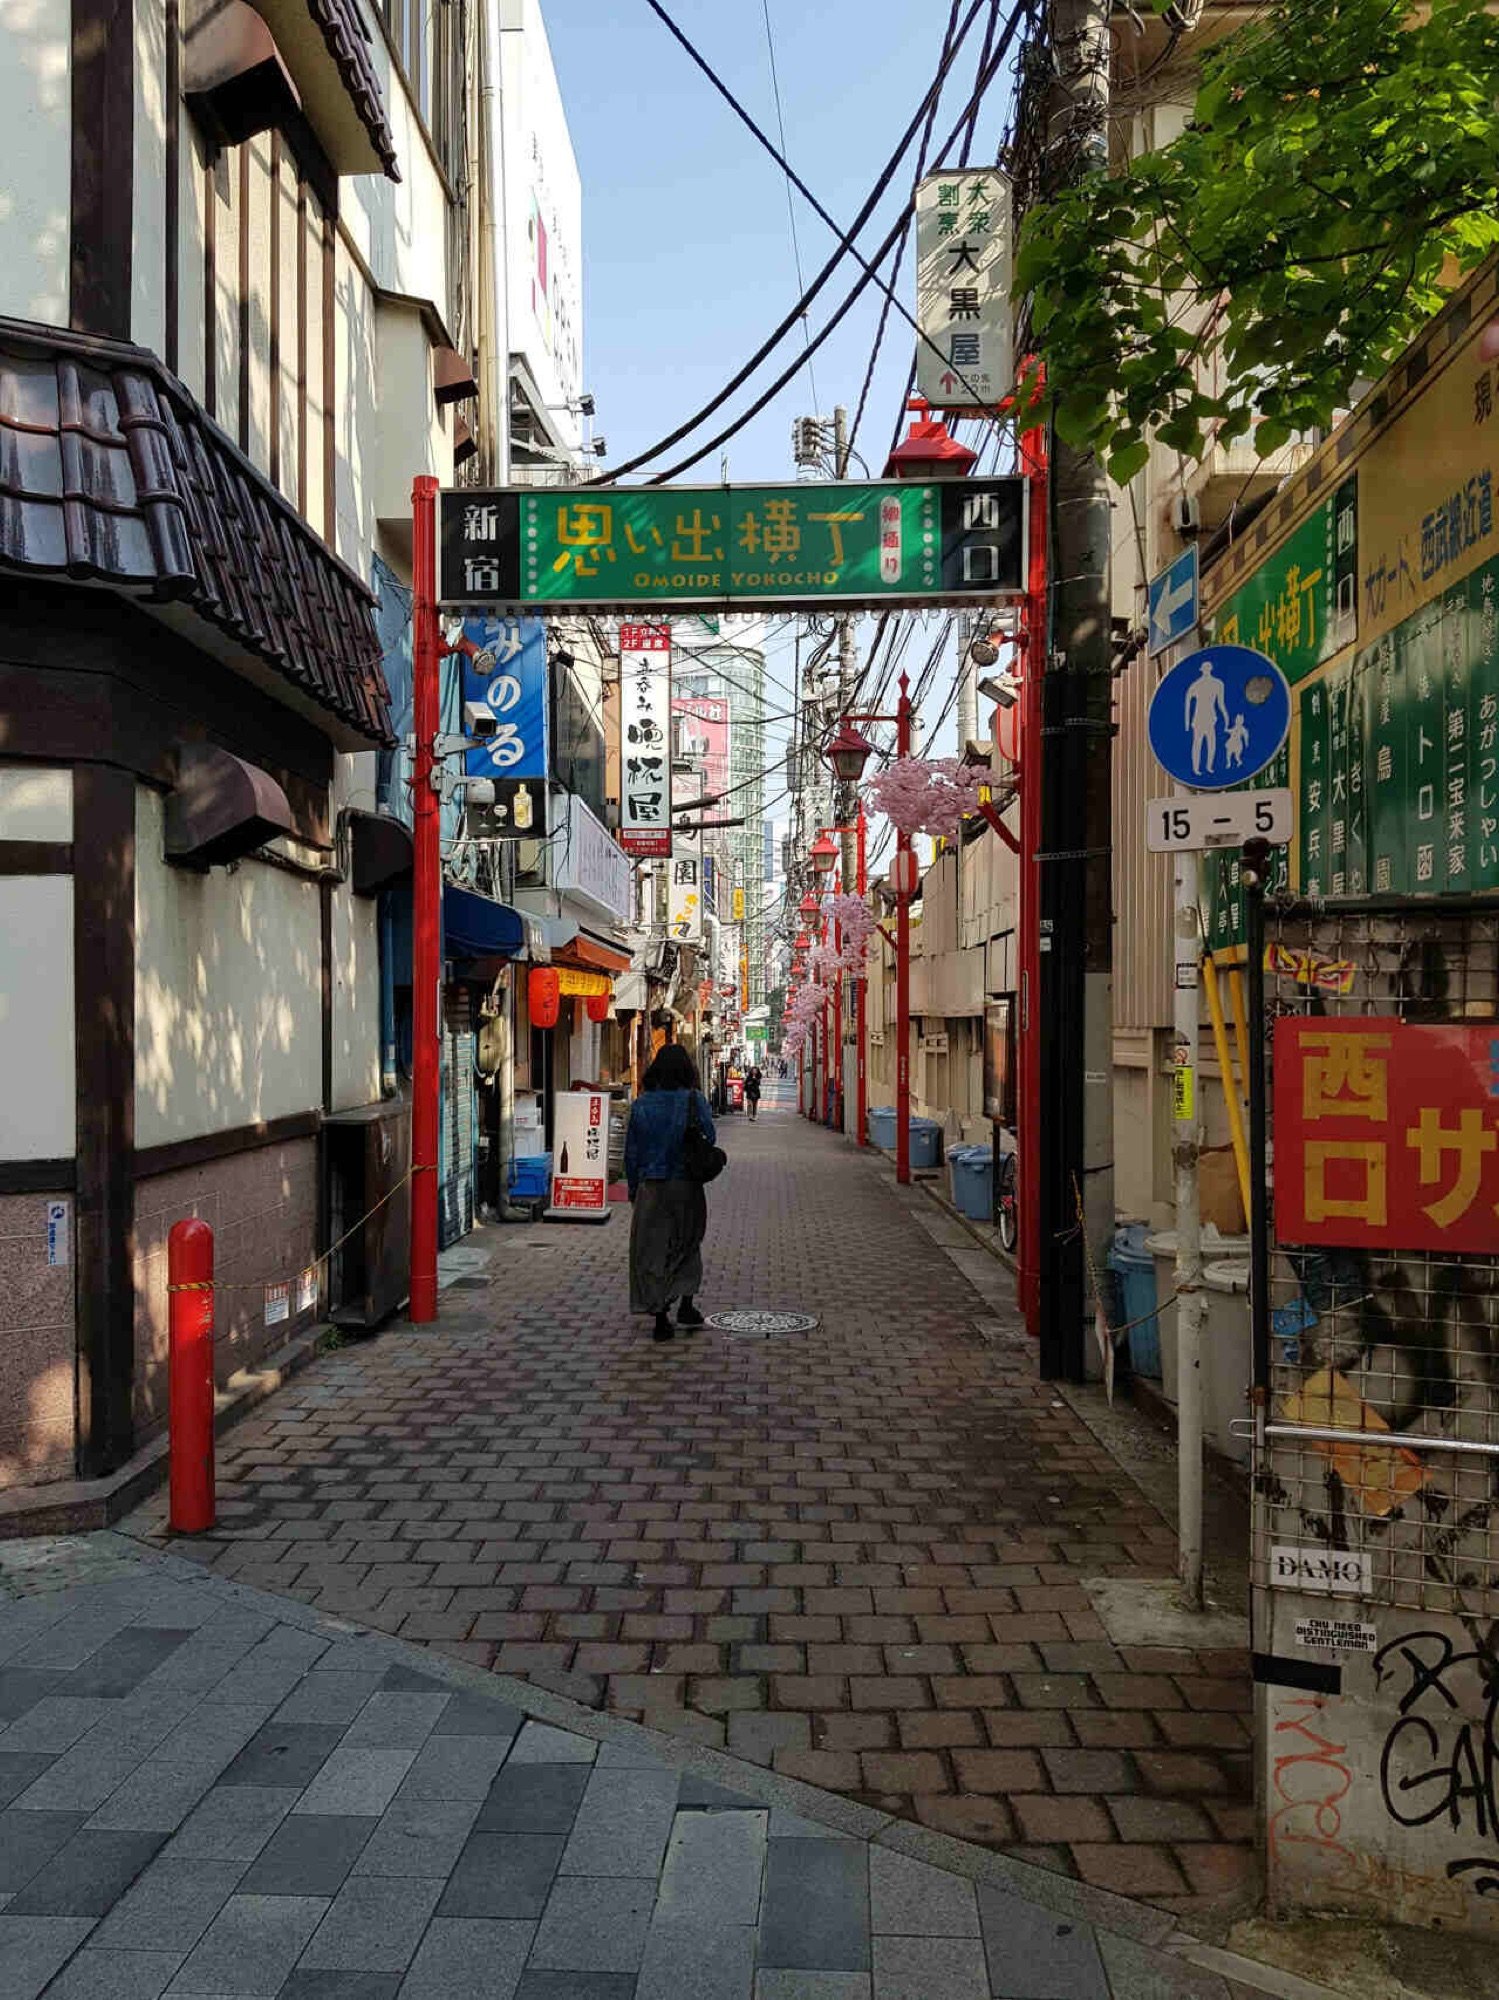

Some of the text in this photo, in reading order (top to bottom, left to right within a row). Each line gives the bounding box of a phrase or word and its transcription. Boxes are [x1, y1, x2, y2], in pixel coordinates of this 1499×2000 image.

[938, 184, 960, 236] 割烹
[967, 182, 990, 235] 大衆
[949, 241, 981, 366] 大黒屋
[462, 503, 499, 593] 新宿
[553, 498, 864, 577] 思い出横丁
[962, 492, 1000, 583] 西口
[634, 571, 838, 588] OMOIDE YOKOCHO
[623, 639, 638, 648] 2F
[485, 620, 525, 767] みのる
[1162, 809, 1191, 840] 15
[1255, 801, 1273, 832] 5
[1447, 708, 1468, 876] 第二宝来家
[1299, 1031, 1393, 1227] 西口
[1406, 1107, 1499, 1229] サ
[1277, 1556, 1363, 1584] DAMO
[1297, 1626, 1375, 1642] DISTINGUISHED
